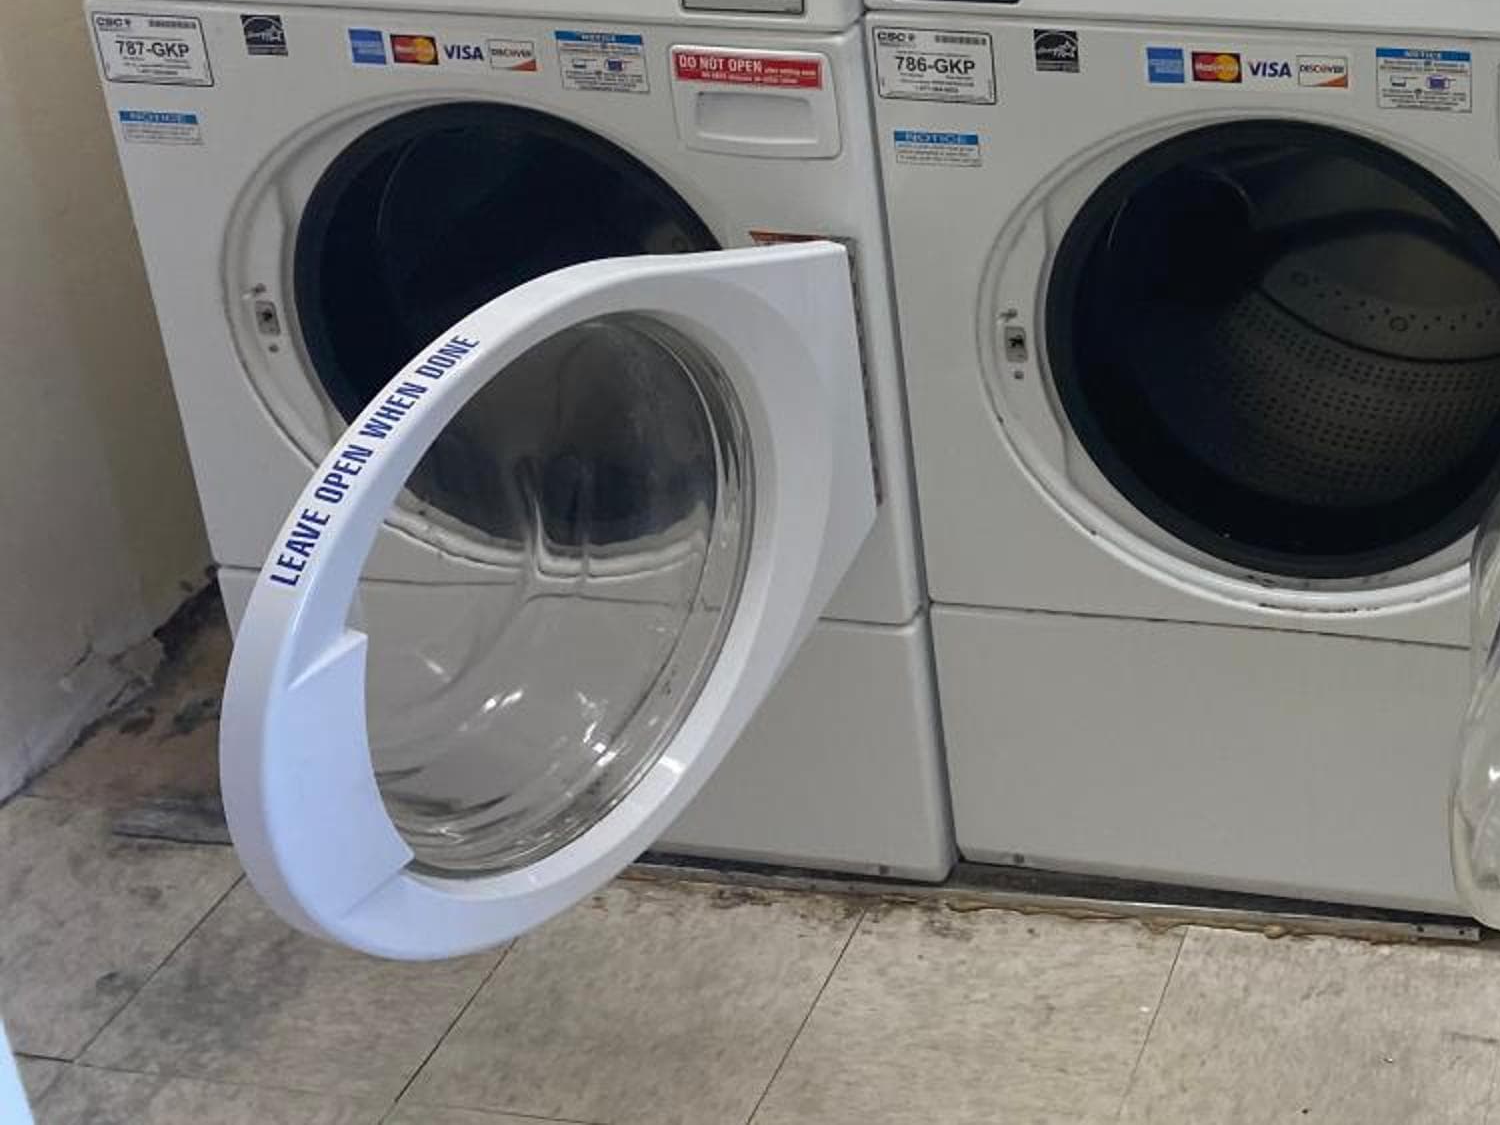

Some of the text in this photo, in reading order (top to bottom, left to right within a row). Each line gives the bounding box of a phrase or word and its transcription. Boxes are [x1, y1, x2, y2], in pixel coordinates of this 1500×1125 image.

[116, 40, 190, 58] 787-GKP
[444, 44, 484, 62] VISA
[679, 54, 697, 69] DO
[700, 56, 725, 71] NOT
[727, 58, 763, 74] OPEN
[895, 56, 975, 74] 786-GKP
[1249, 61, 1292, 78] VISA
[270, 335, 480, 587] LEAVE OPEN WHEN DONE
